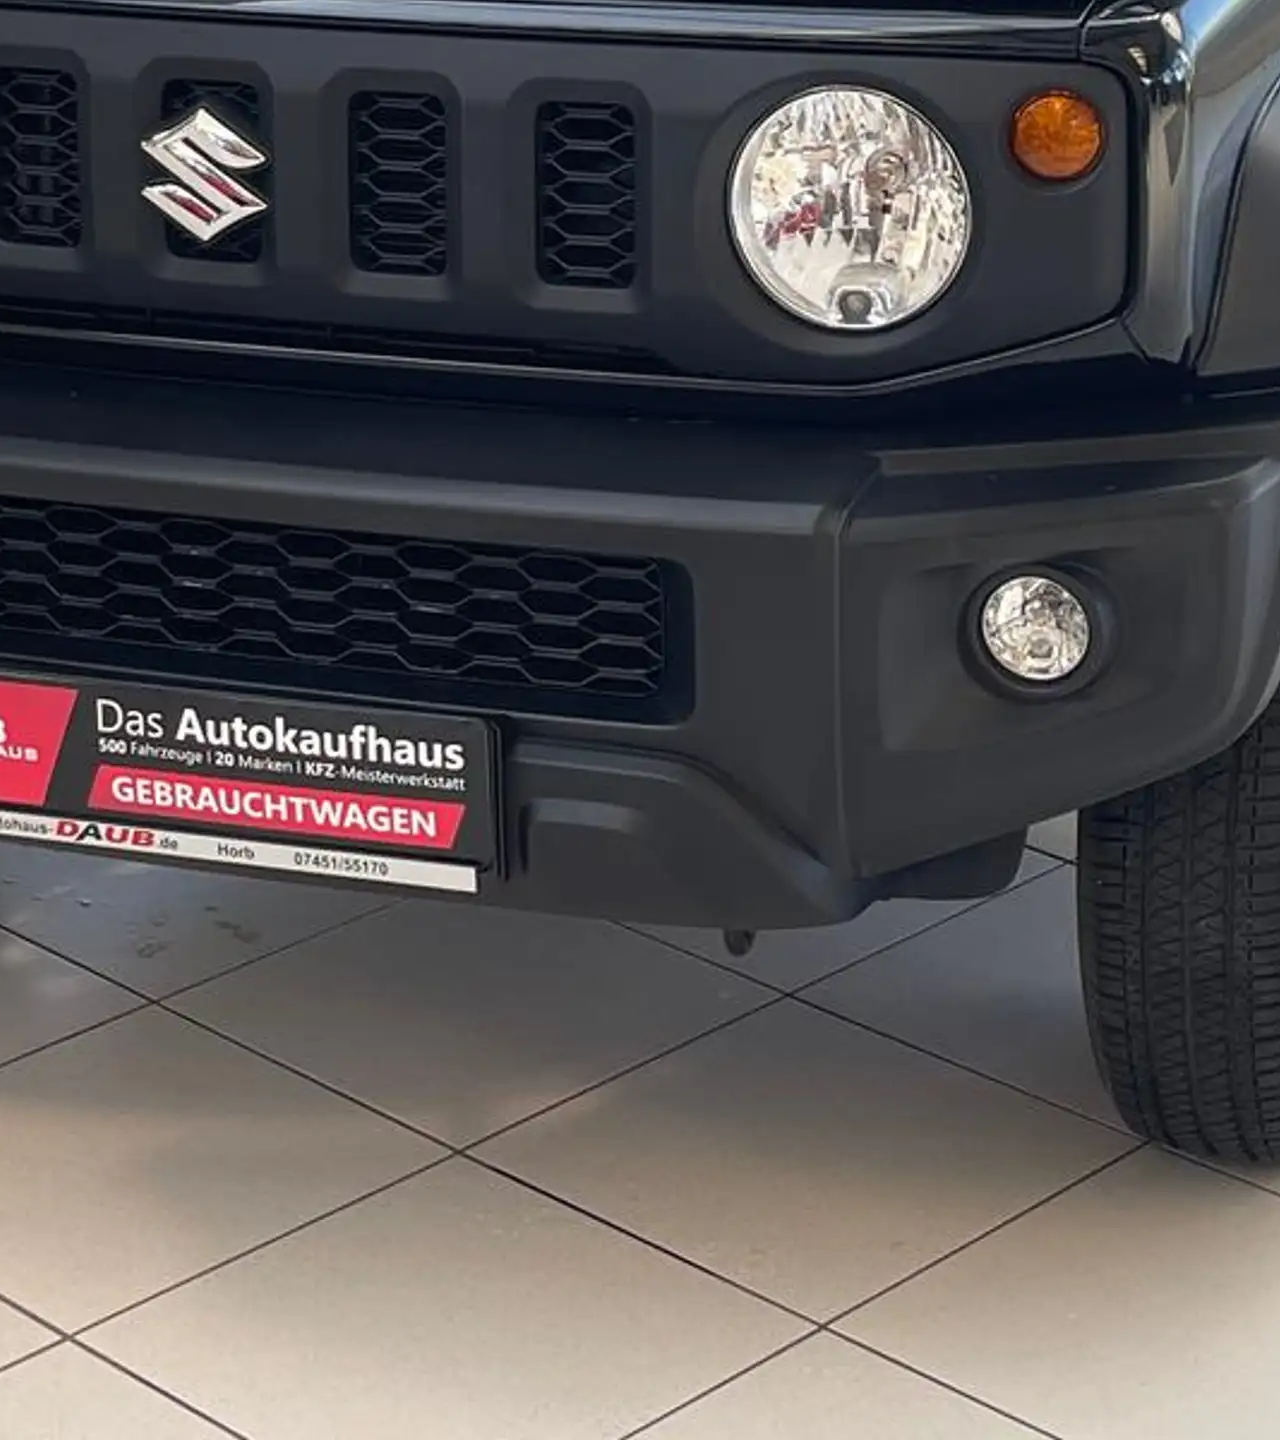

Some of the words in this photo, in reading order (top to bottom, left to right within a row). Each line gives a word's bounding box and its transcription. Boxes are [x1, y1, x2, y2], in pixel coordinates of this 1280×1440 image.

[96, 698, 164, 738] Das
[175, 707, 465, 771] Autokaufhaus
[98, 738, 127, 755] 500
[130, 740, 203, 767] Fahrzeuge
[215, 751, 235, 768] 20
[238, 753, 293, 775] Marken
[305, 761, 466, 792] KFZ-Meisterwerkstatt
[111, 775, 437, 838] GEBRAUCHTWAGEN
[217, 842, 256, 861] Horb
[293, 851, 390, 877] 07451/55170
